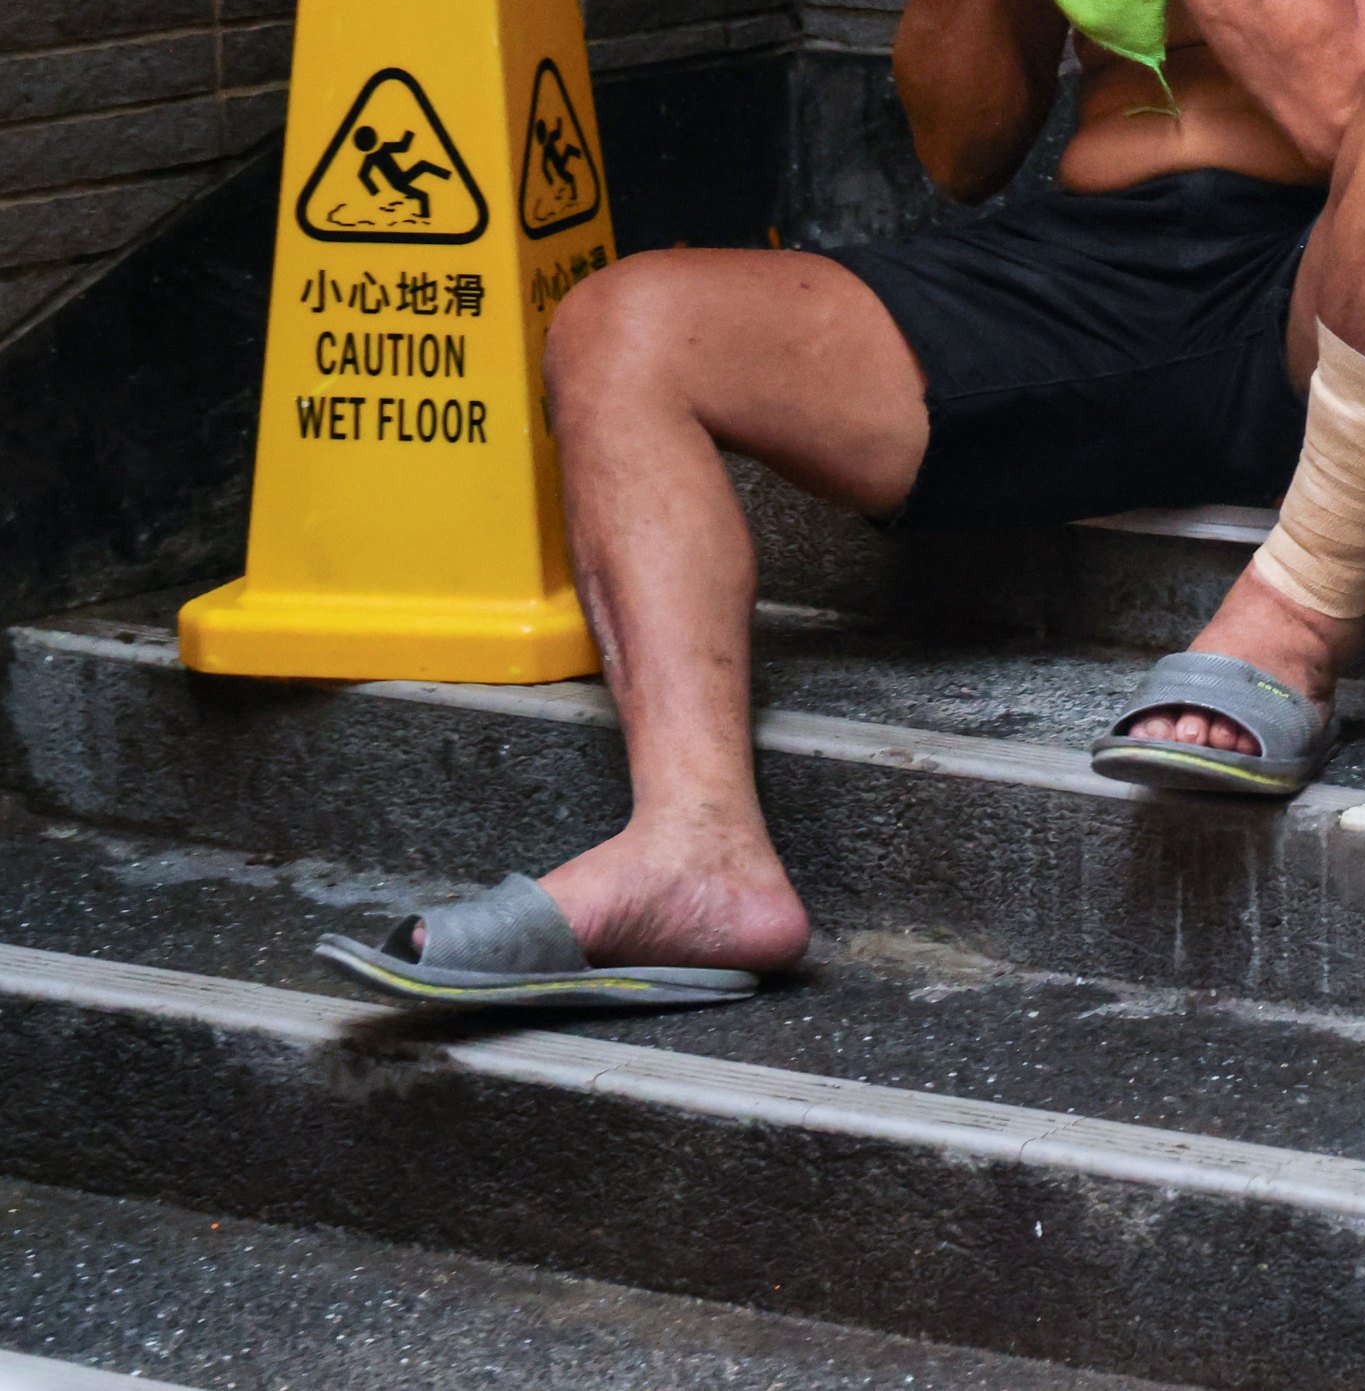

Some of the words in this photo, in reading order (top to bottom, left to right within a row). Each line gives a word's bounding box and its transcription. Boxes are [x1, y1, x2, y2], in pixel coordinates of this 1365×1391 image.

[301, 270, 485, 316] 小心地滑
[316, 331, 465, 378] CAUTION
[296, 396, 366, 440] WET
[377, 398, 487, 444] FLOOR
